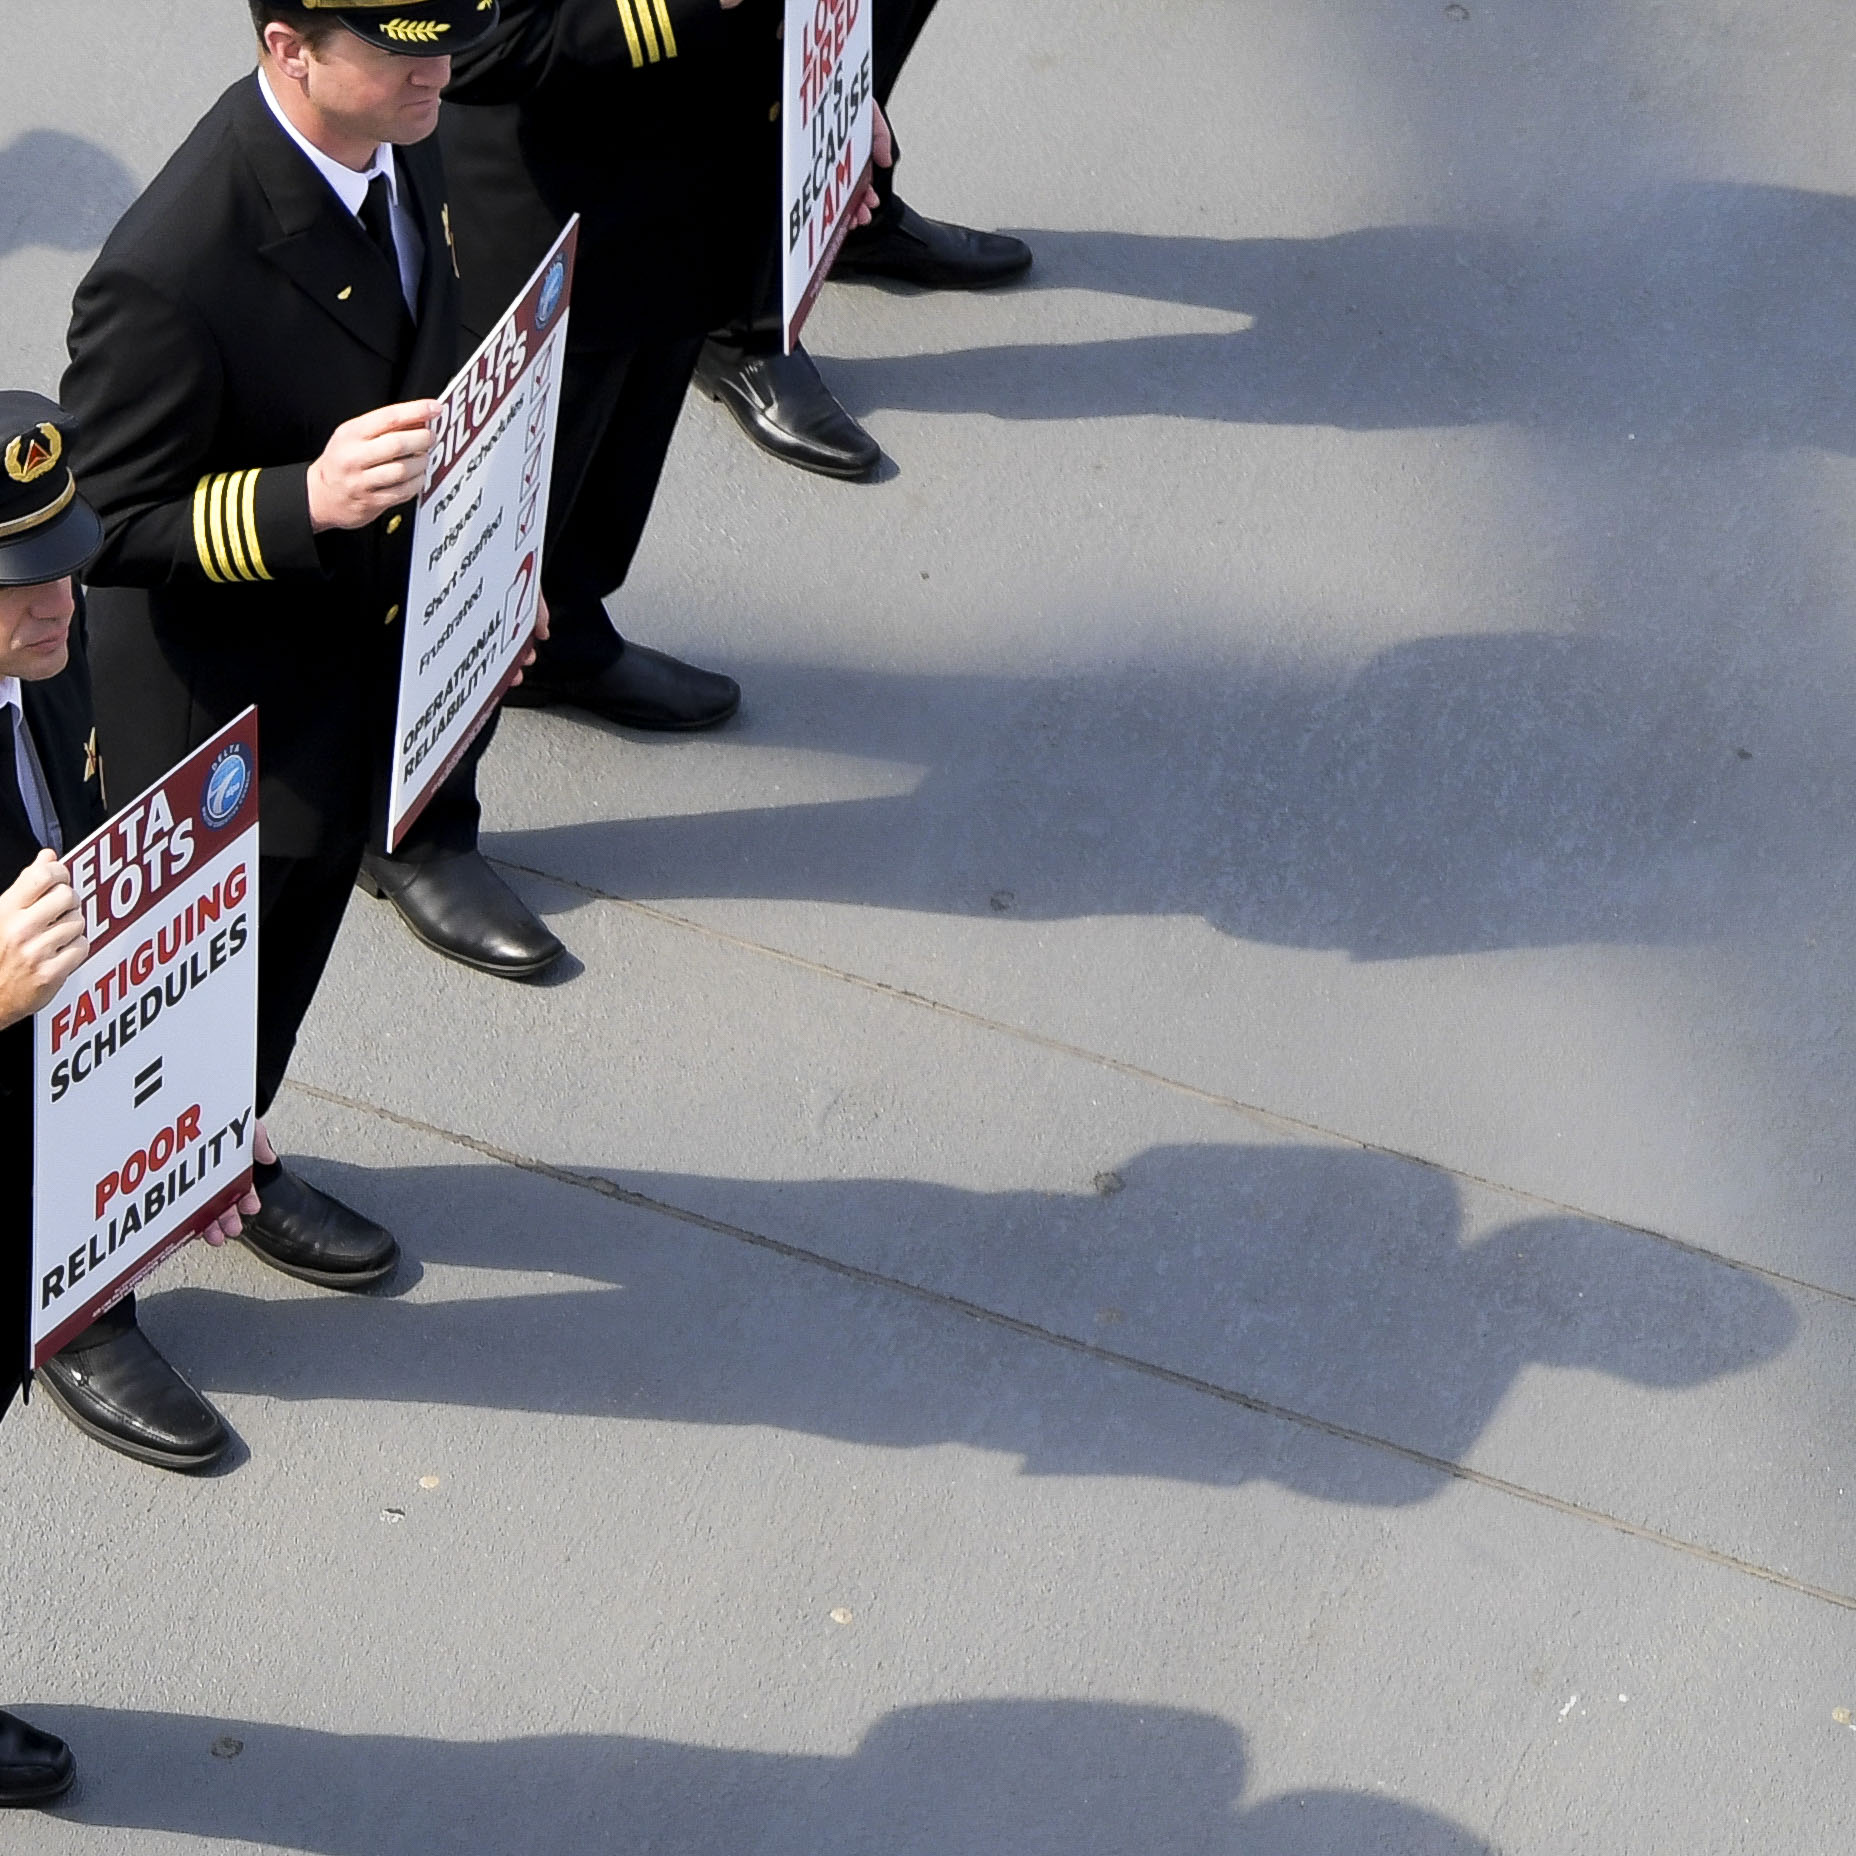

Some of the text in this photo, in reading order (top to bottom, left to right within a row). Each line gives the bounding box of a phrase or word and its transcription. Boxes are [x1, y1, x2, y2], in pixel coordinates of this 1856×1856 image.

[799, 0, 859, 130] TIRED
[812, 60, 843, 159] IT'S
[790, 50, 870, 254] BECAUSE
[807, 217, 815, 271] I
[821, 138, 852, 246] AM
[424, 330, 527, 492] PILOTS
[431, 314, 518, 440] DELTA
[428, 487, 483, 571] Fatigued
[432, 475, 464, 524] Poor
[419, 576, 484, 675] Frustrated
[423, 505, 504, 626] Short Staffed
[402, 608, 502, 755] OPERATIONAL
[402, 642, 498, 785] RELIABILITY?
[72, 789, 174, 899] ELTA
[85, 817, 195, 944] LOTS
[50, 862, 247, 1056] FATIGUING
[50, 913, 248, 1103] SCHEDULES
[40, 1105, 252, 1311] RELIABILITY
[94, 1103, 202, 1221] POOR
